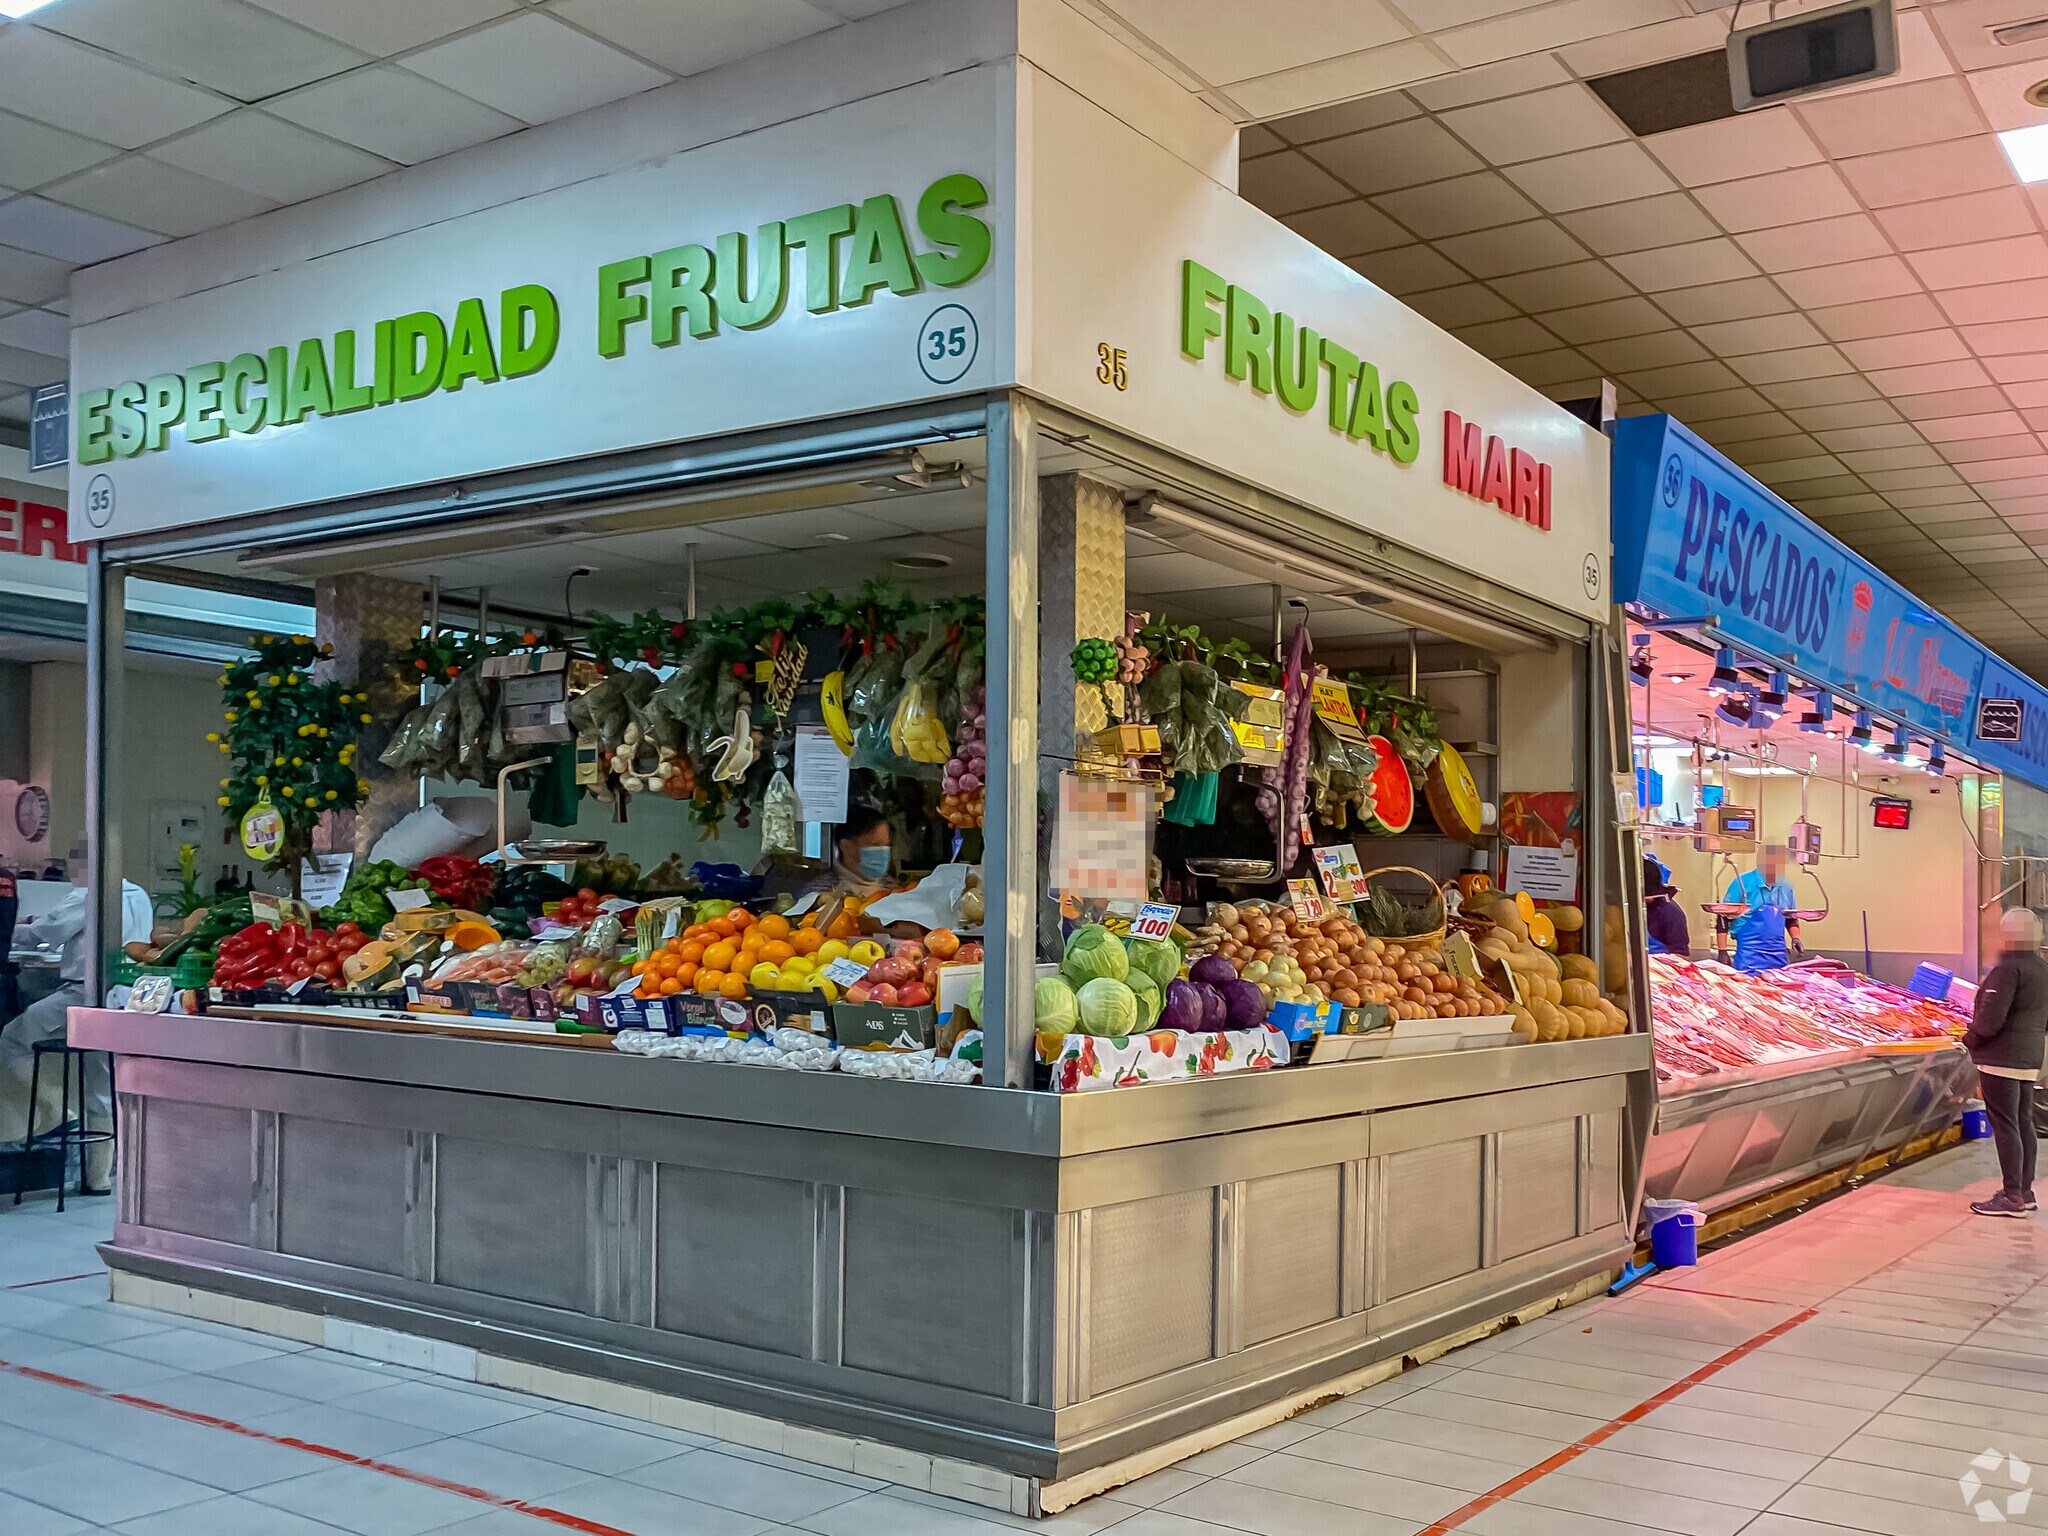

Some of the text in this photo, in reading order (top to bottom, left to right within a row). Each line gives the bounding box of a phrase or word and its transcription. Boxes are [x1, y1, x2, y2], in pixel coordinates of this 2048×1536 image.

[77, 173, 992, 466] ESPECIALIDAD FRUTAS
[928, 326, 966, 361] 35
[1096, 342, 1128, 391] 35
[1180, 259, 1552, 531] FRUTAS MARI
[1664, 464, 1681, 498] 36
[91, 489, 109, 511] 35
[1585, 566, 1597, 586] 35
[1674, 475, 1836, 653] PESCADOS
[1319, 687, 1334, 697] HAY
[1323, 871, 1339, 898] 2
[1136, 918, 1168, 936] 100
